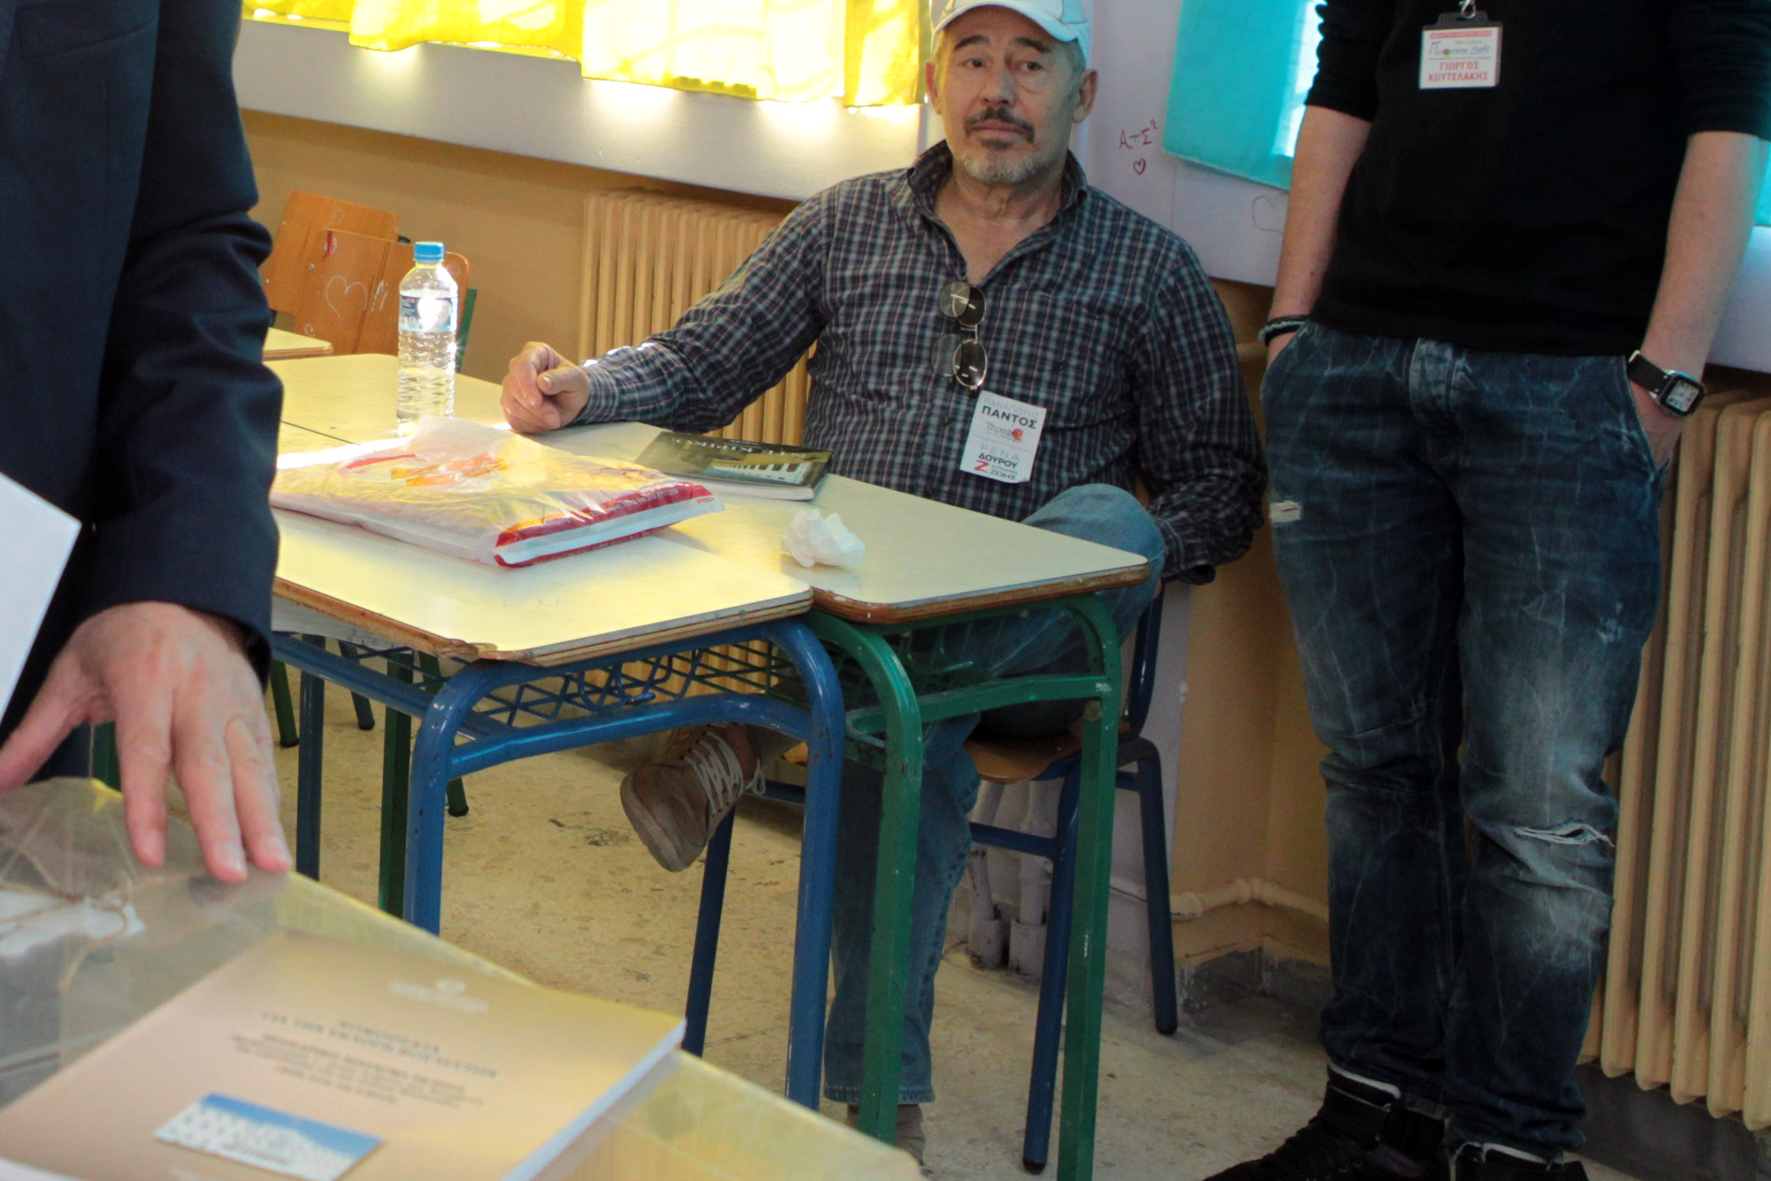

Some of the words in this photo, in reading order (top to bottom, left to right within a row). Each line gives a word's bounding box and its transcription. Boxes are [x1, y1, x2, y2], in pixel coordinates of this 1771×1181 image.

[1440, 61, 1479, 71] ΓΙΩΡΓΟΣ
[1428, 72, 1488, 82] ΚΟΥΤΕΛΑΚΗΣ
[981, 405, 1037, 429] ΠΑΝΤΟΣ
[978, 452, 1018, 469] ΔΟΥΡΟΥ
[980, 443, 1019, 461] ΡΕΝΑ
